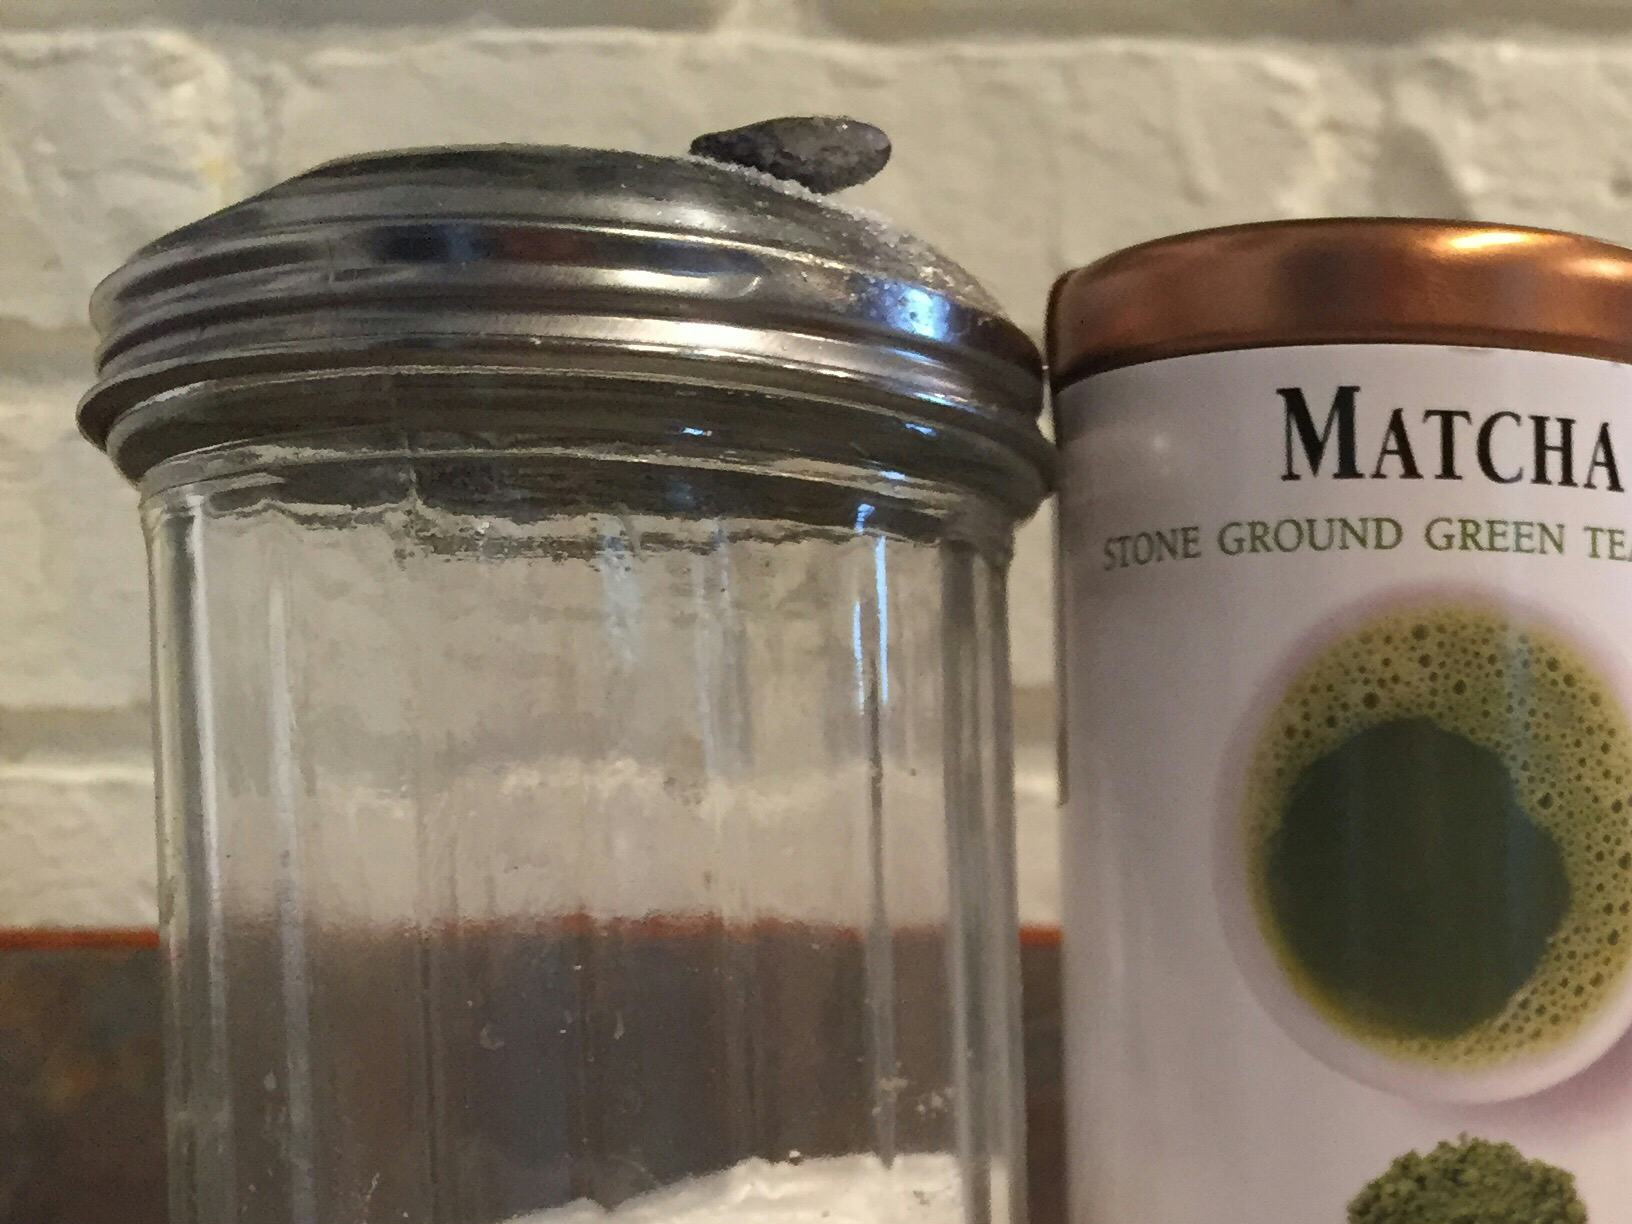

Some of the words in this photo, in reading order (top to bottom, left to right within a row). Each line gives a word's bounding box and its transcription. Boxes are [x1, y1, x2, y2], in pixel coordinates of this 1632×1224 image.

[1276, 385, 1626, 494] MATCHA
[1103, 526, 1203, 572] STONE
[1218, 517, 1404, 557] GROUND
[1424, 518, 1566, 557] GREEN
